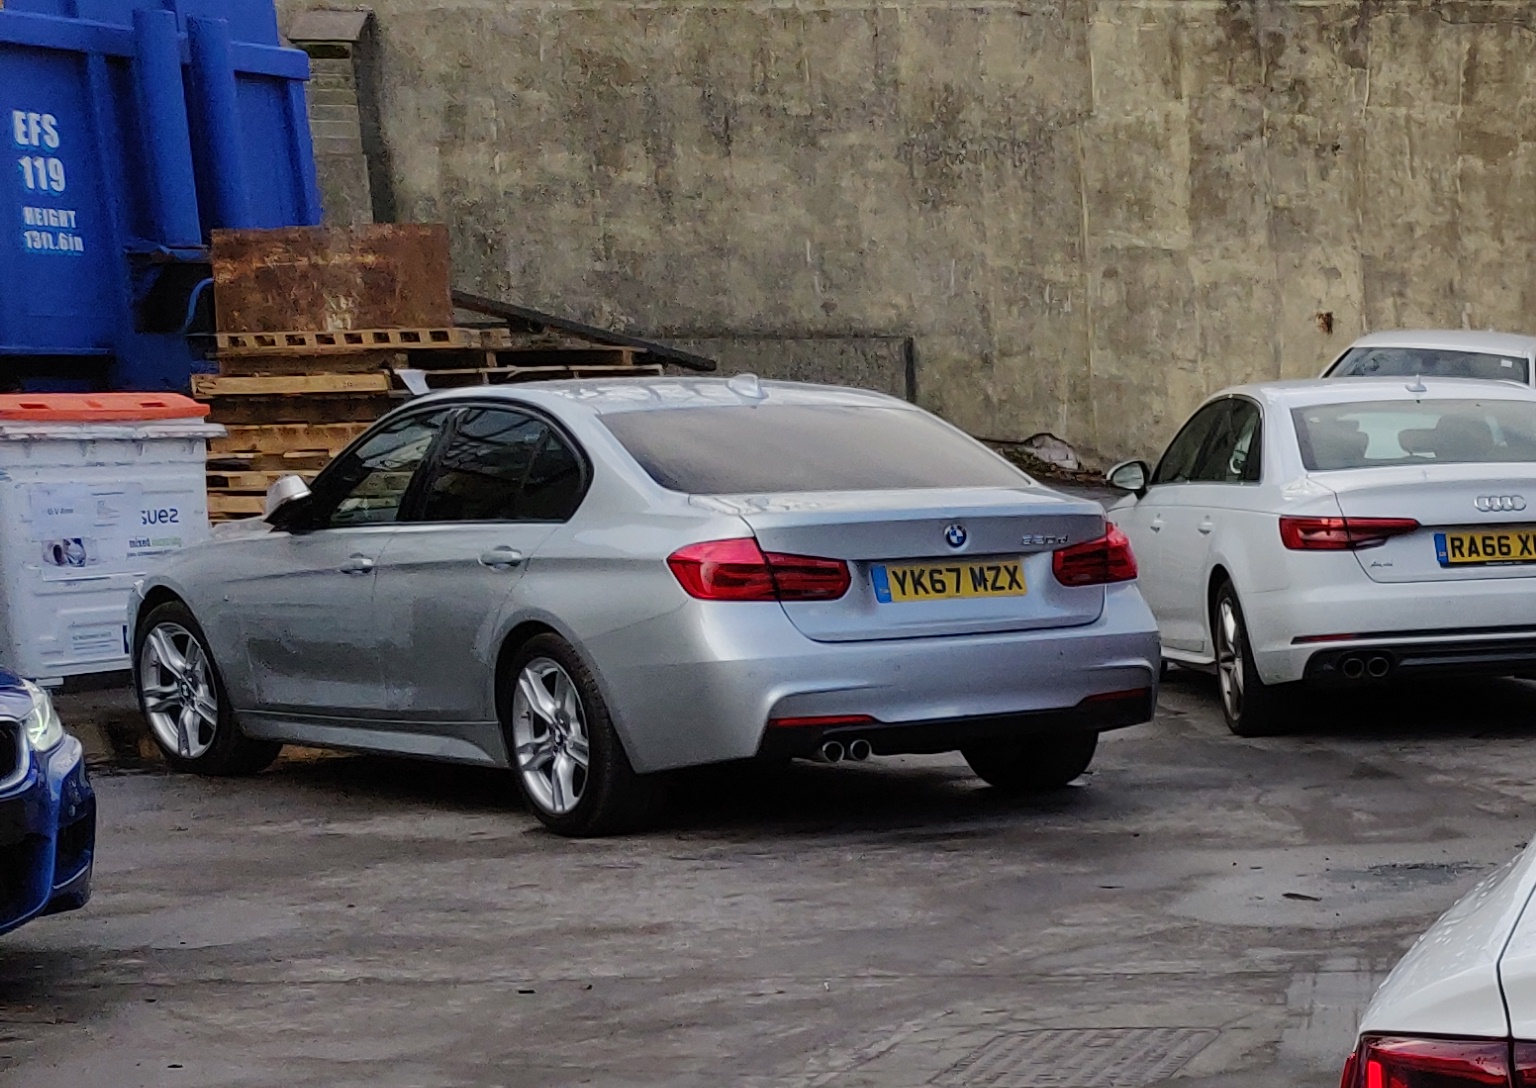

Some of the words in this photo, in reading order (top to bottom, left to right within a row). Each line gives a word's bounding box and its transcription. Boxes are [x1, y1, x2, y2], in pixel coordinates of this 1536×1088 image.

[12, 110, 60, 148] EFS
[18, 155, 66, 192] 119
[22, 206, 76, 228] HEIGHT
[1450, 535, 1511, 558] RA66
[892, 566, 961, 596] YK67
[969, 564, 1023, 593] MZX
